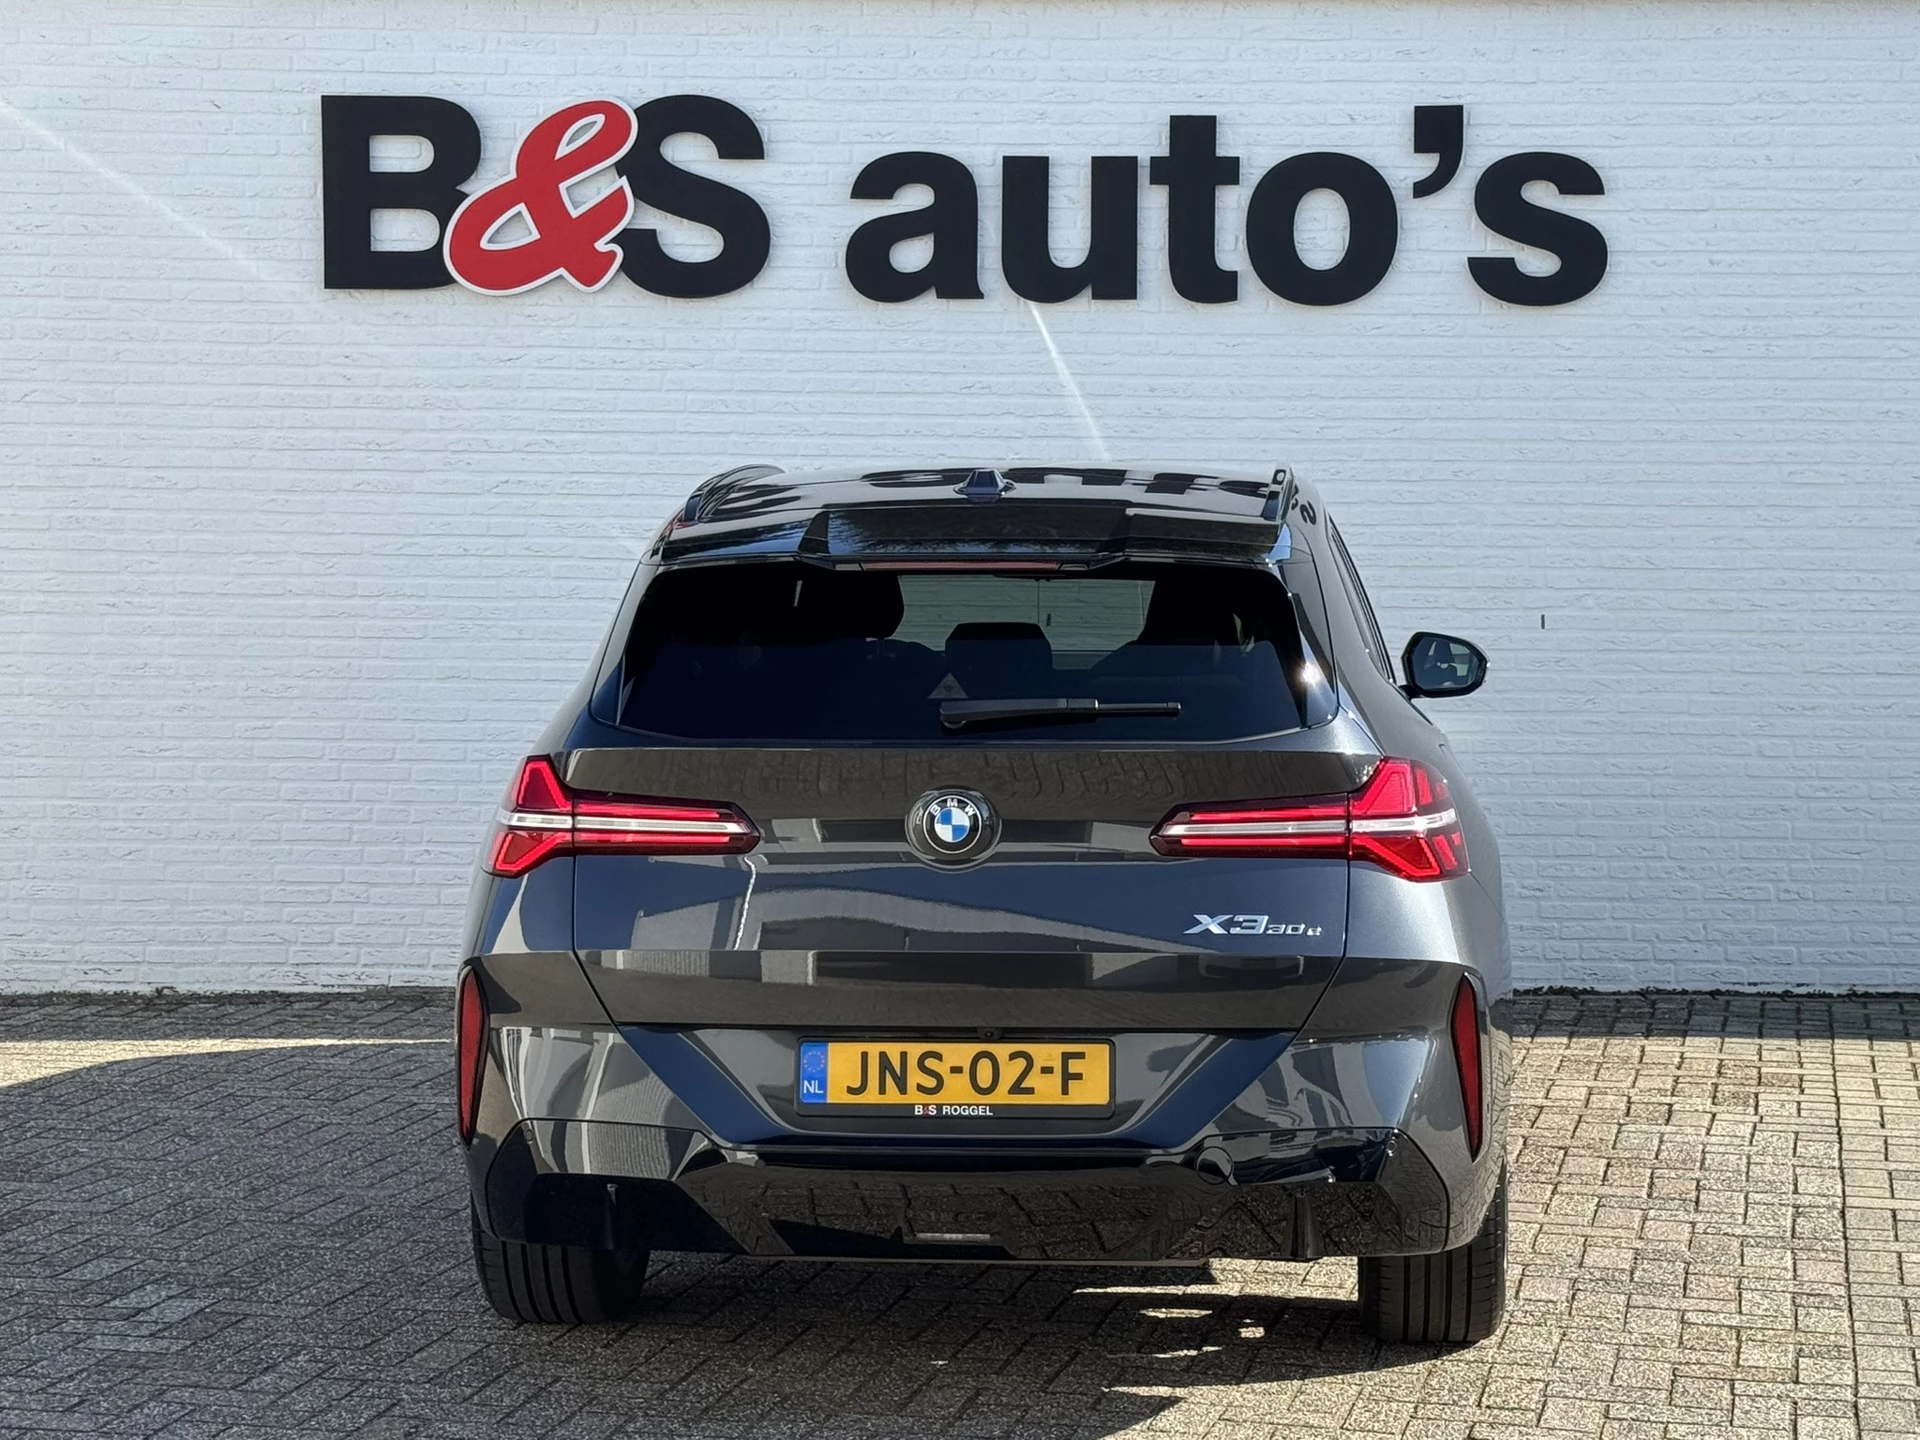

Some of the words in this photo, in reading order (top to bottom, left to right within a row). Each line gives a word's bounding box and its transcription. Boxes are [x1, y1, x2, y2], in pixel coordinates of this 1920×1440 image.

[321, 94, 771, 298] B&S
[929, 798, 977, 817] BMW
[803, 1080, 824, 1094] NL
[846, 1050, 1086, 1096] JNS-02-F
[942, 1105, 994, 1116] ROGGEL
